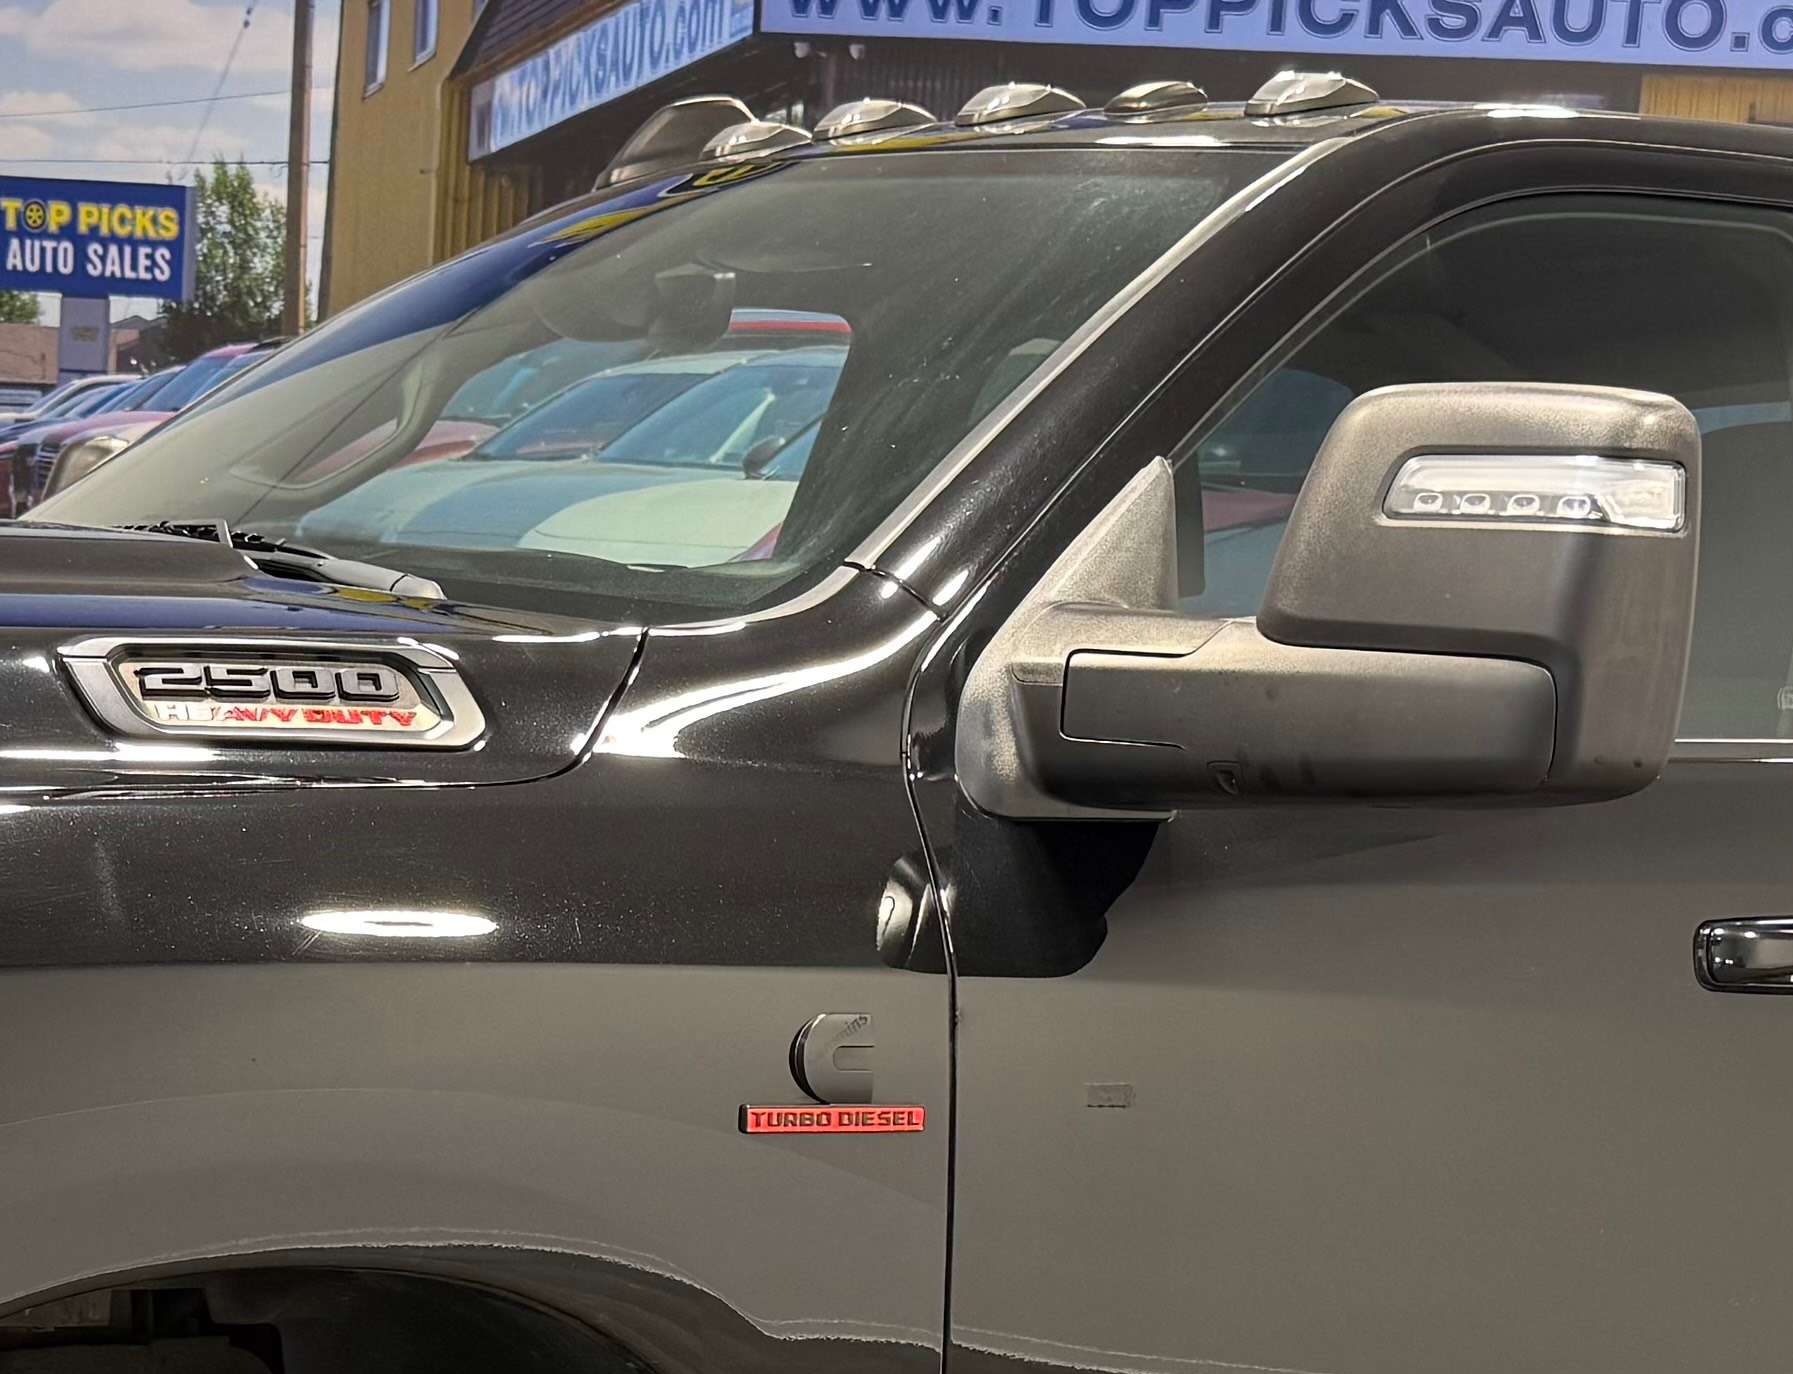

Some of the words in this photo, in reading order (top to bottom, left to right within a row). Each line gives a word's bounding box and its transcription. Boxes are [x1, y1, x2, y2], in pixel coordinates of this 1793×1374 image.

[0, 198, 72, 234] TOP
[77, 202, 180, 240] PICKS
[6, 238, 74, 274] AUTO
[86, 242, 172, 282] SALES
[134, 666, 399, 702] 2500
[154, 703, 296, 722] HEAVY
[304, 707, 418, 726] DUTY
[751, 1111, 832, 1128] TURBO
[837, 1110, 921, 1127] DIESEL
